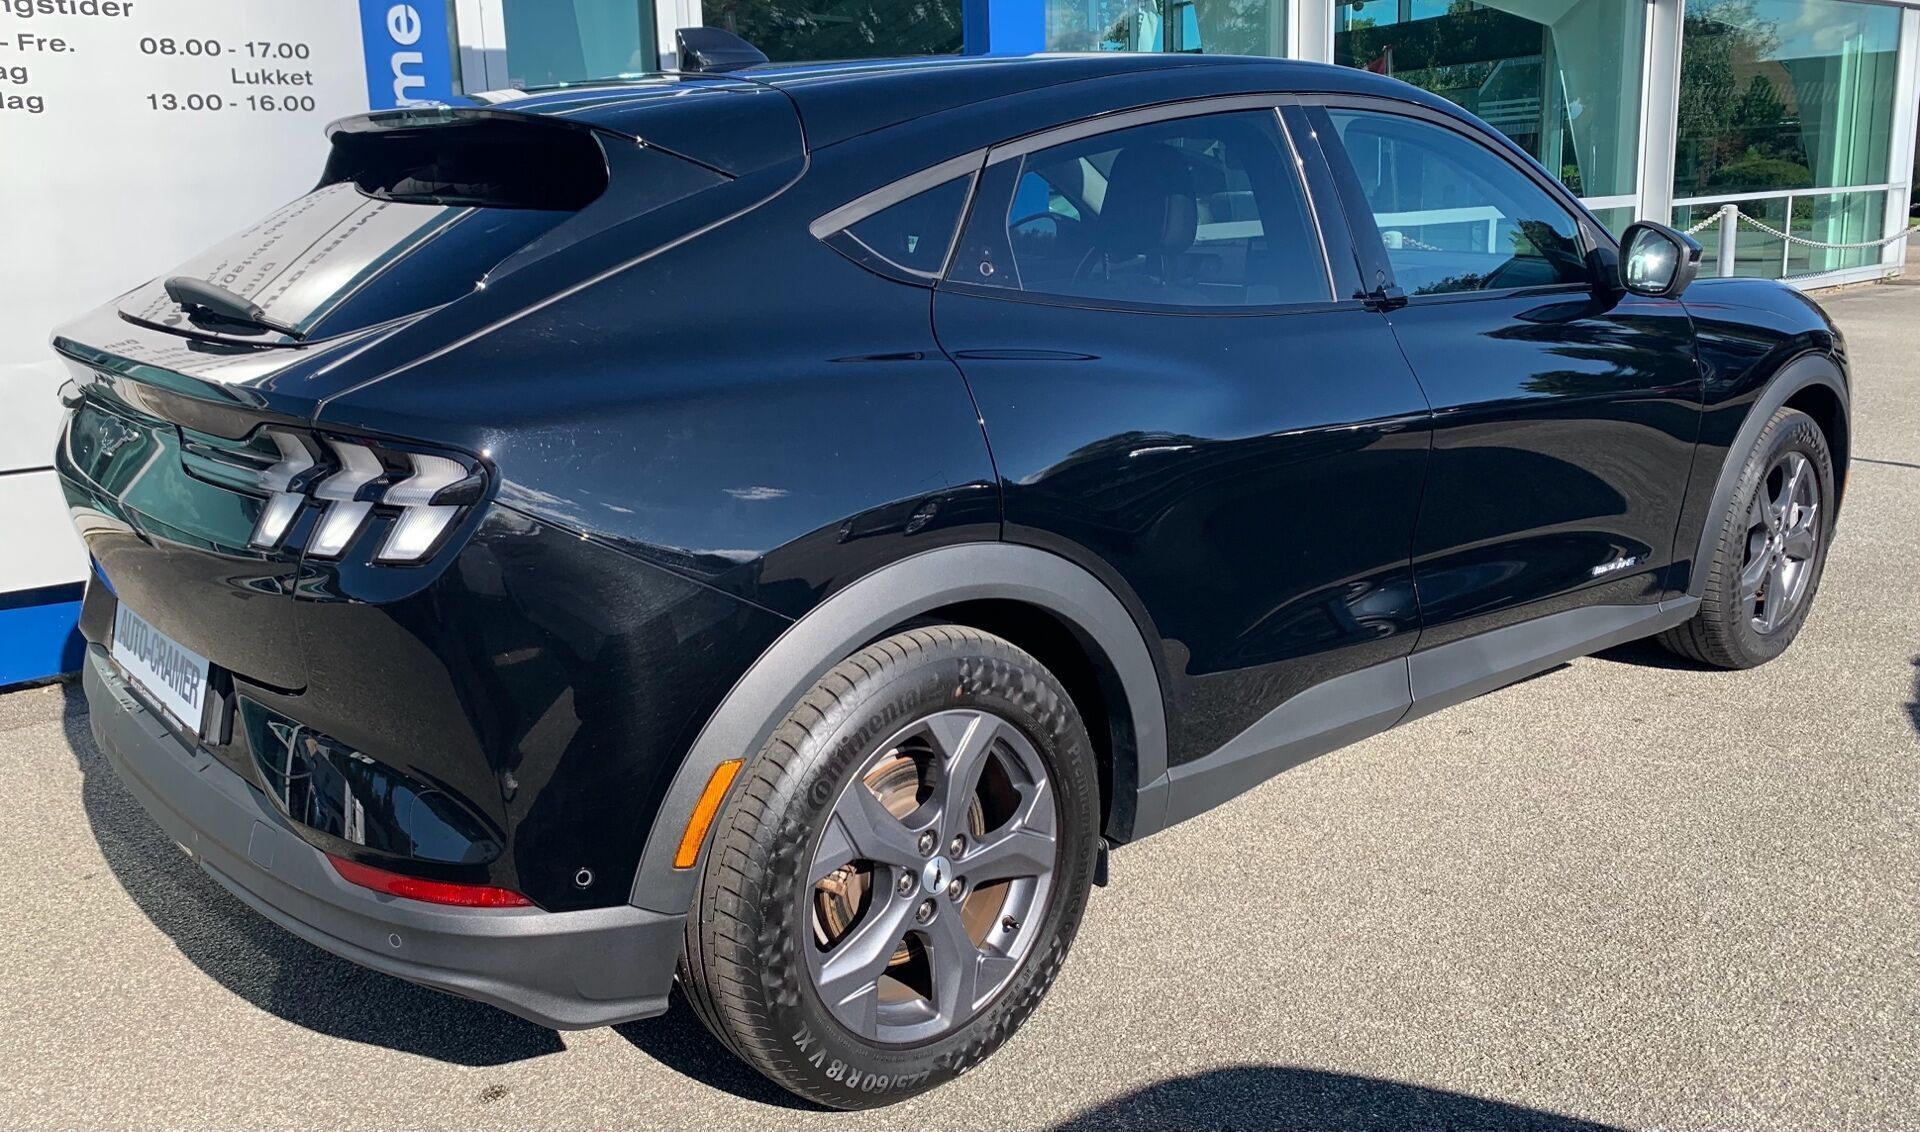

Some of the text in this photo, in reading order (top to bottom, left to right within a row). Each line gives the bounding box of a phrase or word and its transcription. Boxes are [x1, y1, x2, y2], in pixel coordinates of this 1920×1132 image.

[17, 33, 75, 53] Fre.
[139, 37, 222, 57] 08.00
[245, 41, 310, 60] 17.00
[231, 67, 314, 86] Lukket
[146, 93, 223, 111] 13.00
[246, 95, 316, 112] 16.00
[118, 608, 201, 710] AUTO-CRAMER
[791, 1019, 817, 1053] XL
[808, 1047, 828, 1069] V
